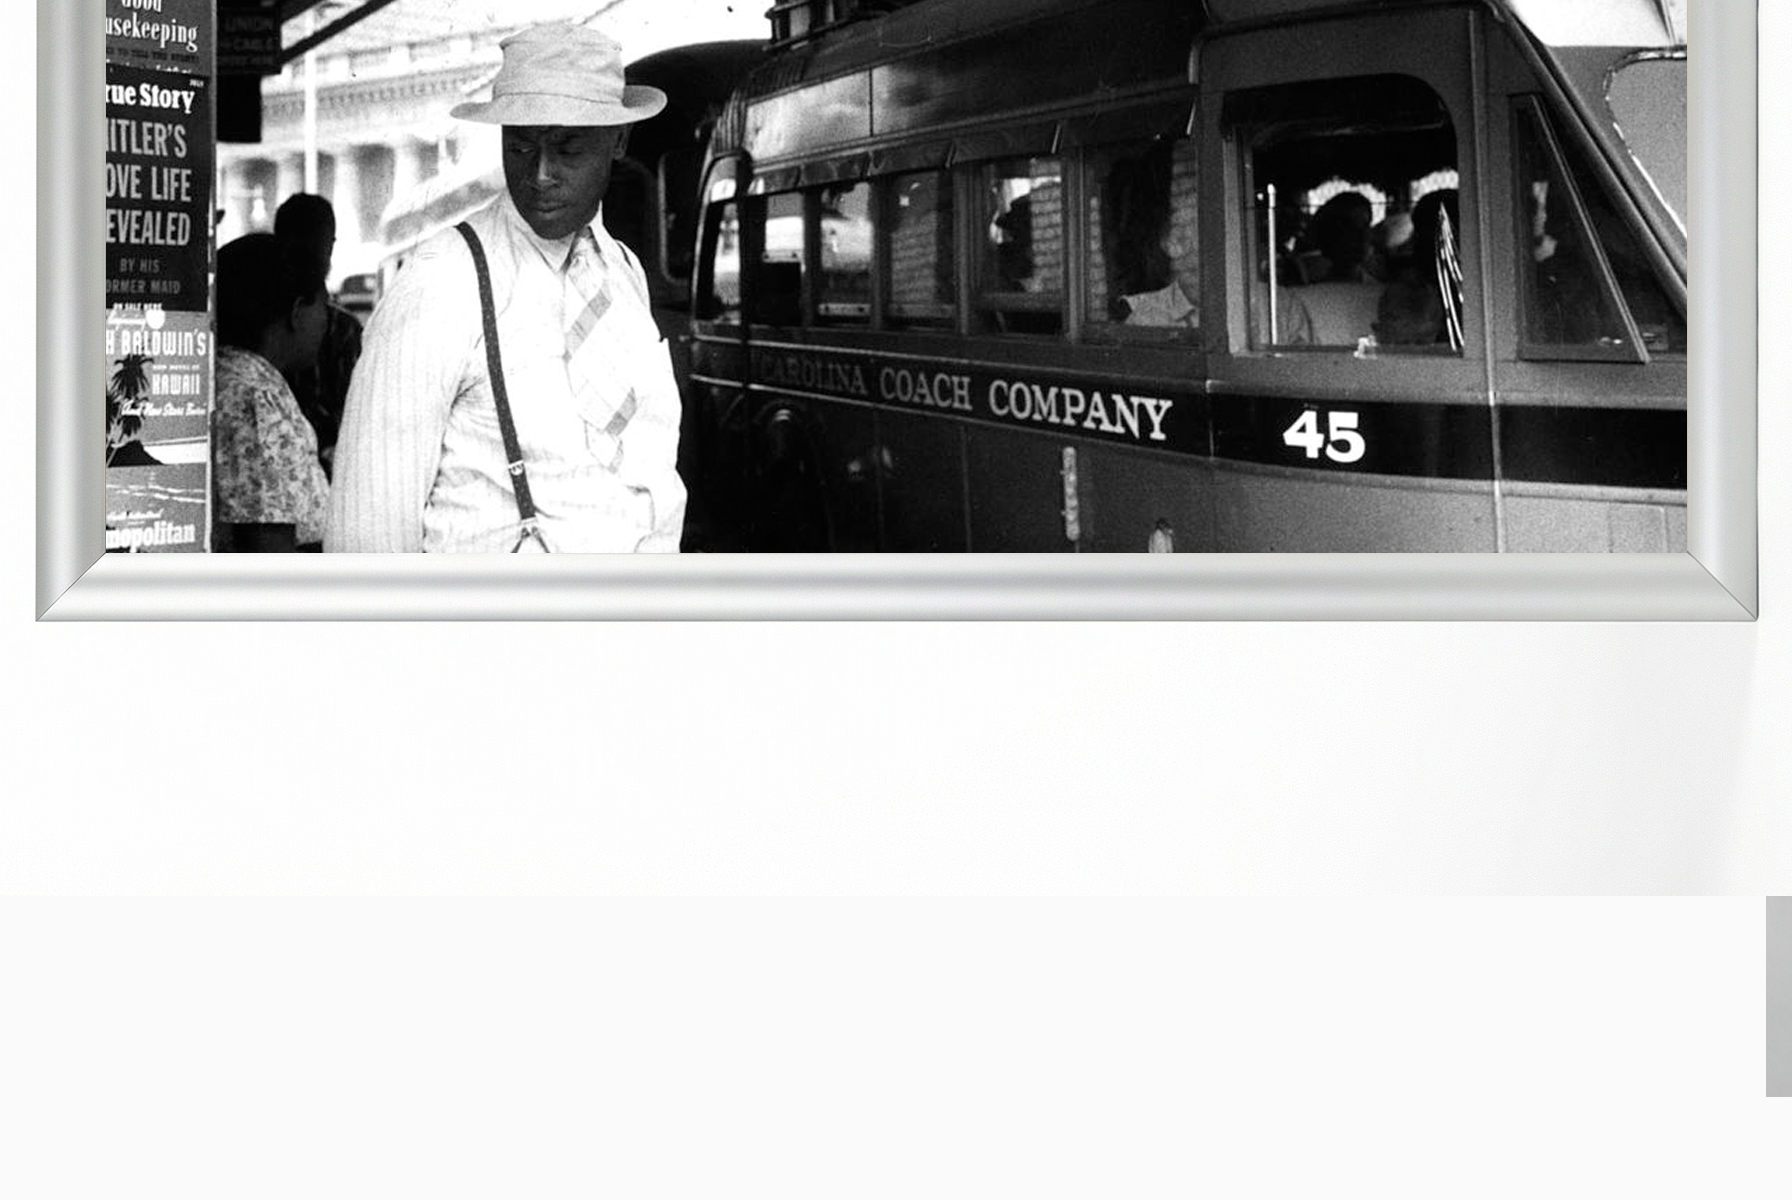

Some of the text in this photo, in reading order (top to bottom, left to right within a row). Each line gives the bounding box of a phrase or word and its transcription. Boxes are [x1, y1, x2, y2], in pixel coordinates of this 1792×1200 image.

[139, 82, 196, 114] Story
[151, 165, 192, 202] LIFE
[106, 208, 191, 247] EVEALED
[119, 257, 161, 274] BY HIS
[150, 279, 181, 295] MAID
[121, 328, 207, 357] BALDWIN'S
[152, 373, 201, 396] HAWAII
[760, 350, 1174, 443] CAROLINA COACH COMPANY
[1281, 409, 1367, 464] 45
